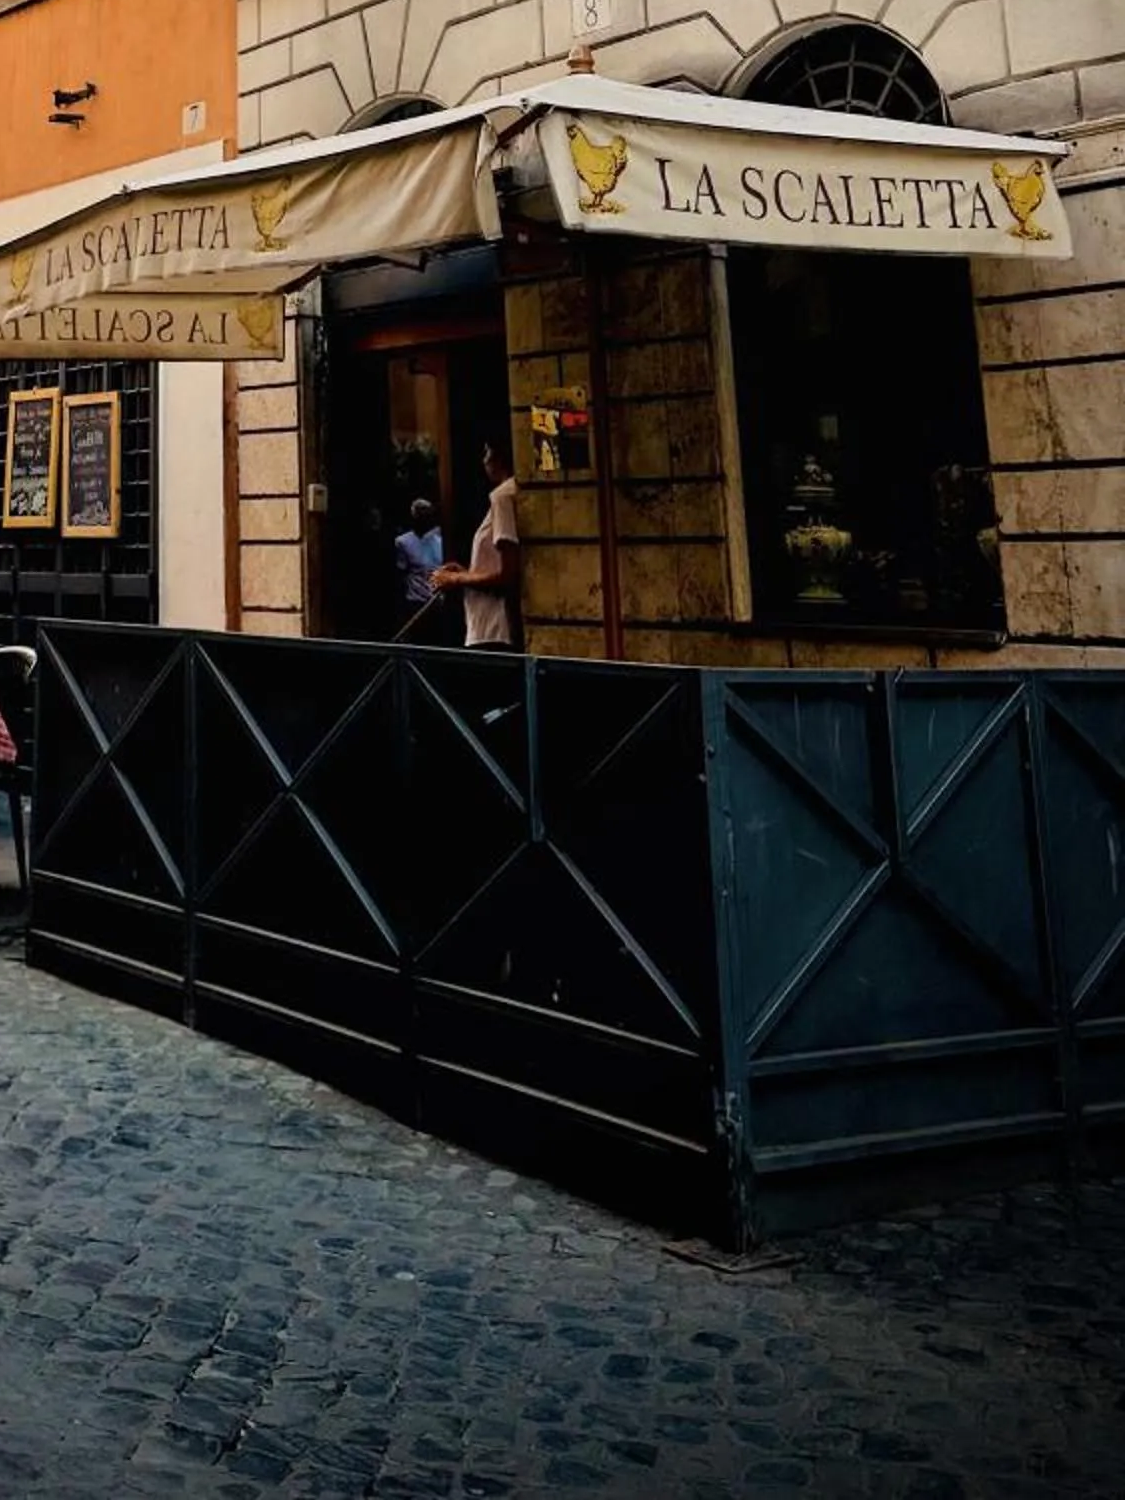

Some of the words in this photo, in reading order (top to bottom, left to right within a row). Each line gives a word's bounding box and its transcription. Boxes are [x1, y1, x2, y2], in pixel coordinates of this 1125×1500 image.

[188, 105, 200, 131] 7
[655, 157, 726, 216] LA
[742, 165, 998, 229] SCALETTA
[45, 244, 75, 287] LA
[81, 205, 231, 273] SCALETTA
